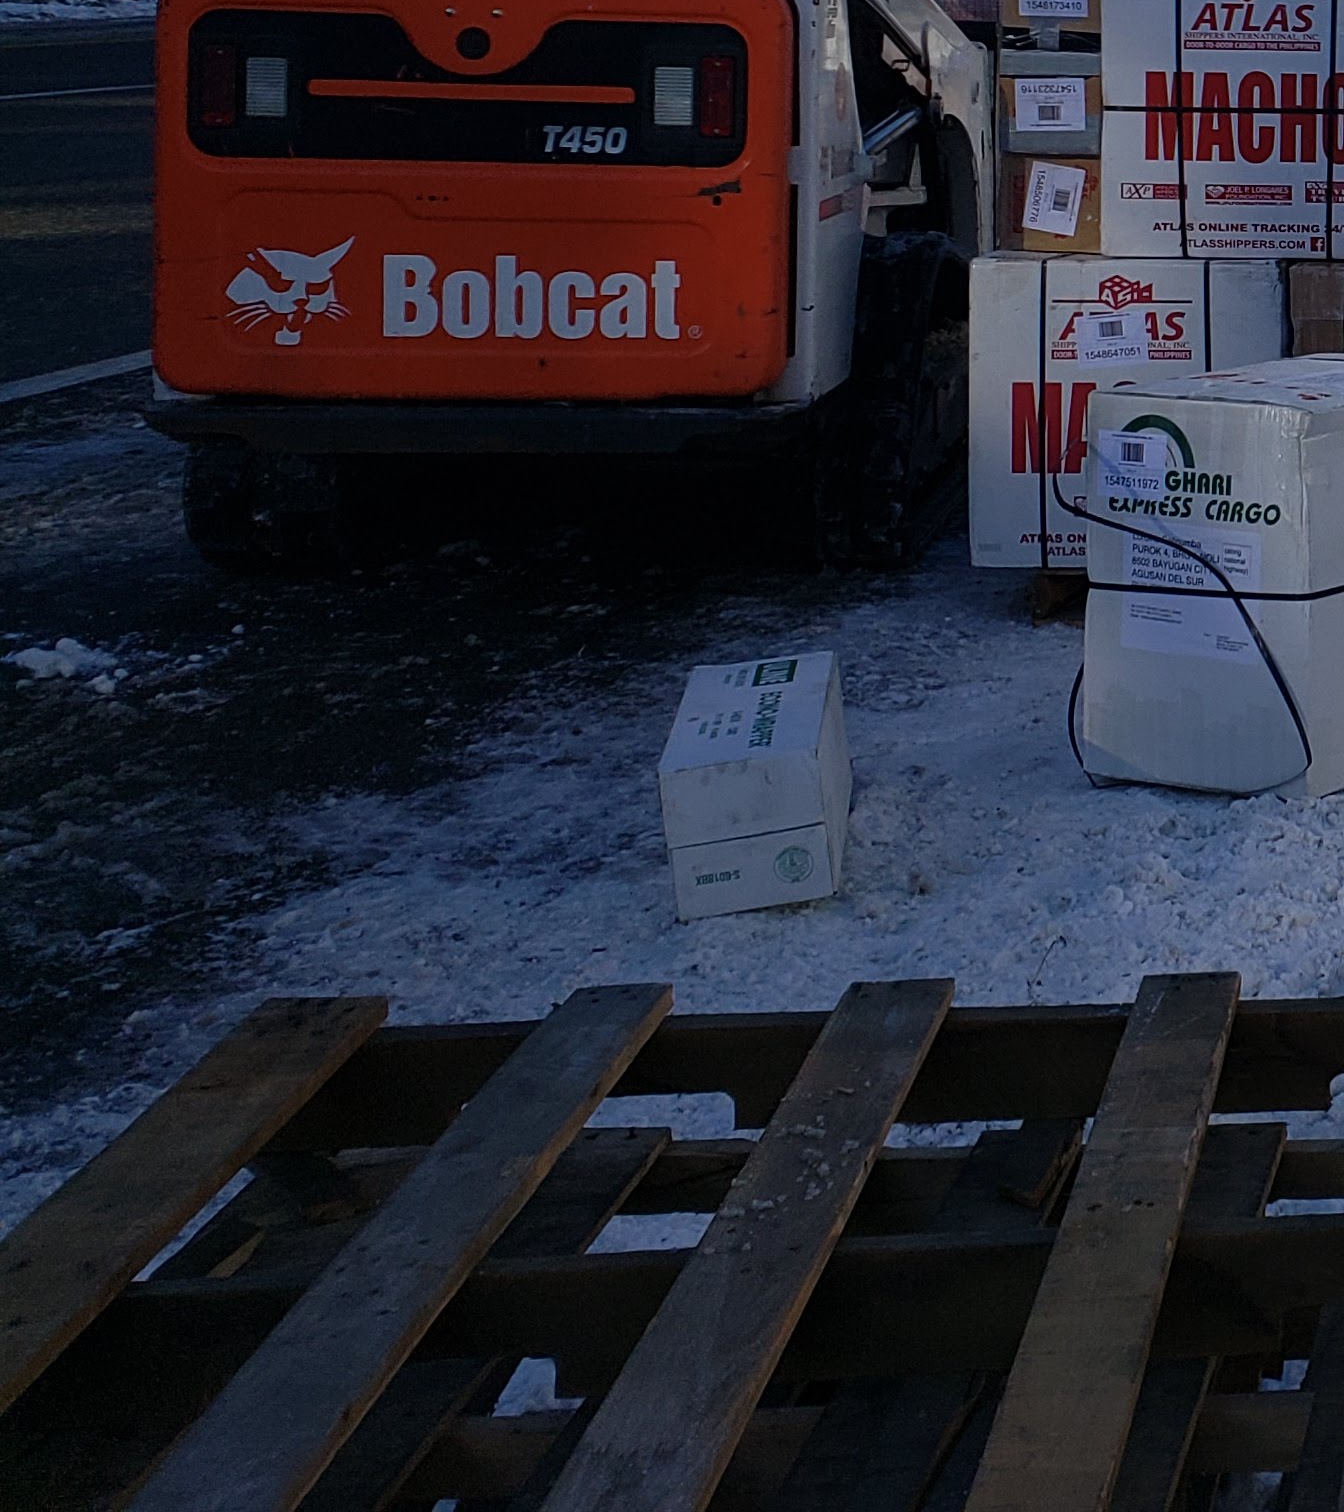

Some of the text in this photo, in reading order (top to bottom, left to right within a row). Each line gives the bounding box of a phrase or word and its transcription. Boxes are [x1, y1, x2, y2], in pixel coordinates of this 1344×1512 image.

[1191, 2, 1314, 32] ATLAS
[1021, 84, 1077, 94] 1547323116
[541, 125, 628, 155] T450
[1198, 223, 1248, 233] ONLINE
[1251, 223, 1320, 234] TRACKING
[1179, 238, 1306, 250] TLASSHIPPERS.COM
[382, 252, 682, 341] Bobcat
[1084, 346, 1142, 361] 1548647051
[1149, 351, 1191, 360] PHILIPPINES
[1104, 475, 1160, 490] 1547511972
[1164, 470, 1233, 496] GHARI
[1108, 495, 1281, 526] EXPRESS CARGO
[1132, 544, 1163, 557] PUROK
[1131, 570, 1204, 587] AGUSAN DEL SUR
